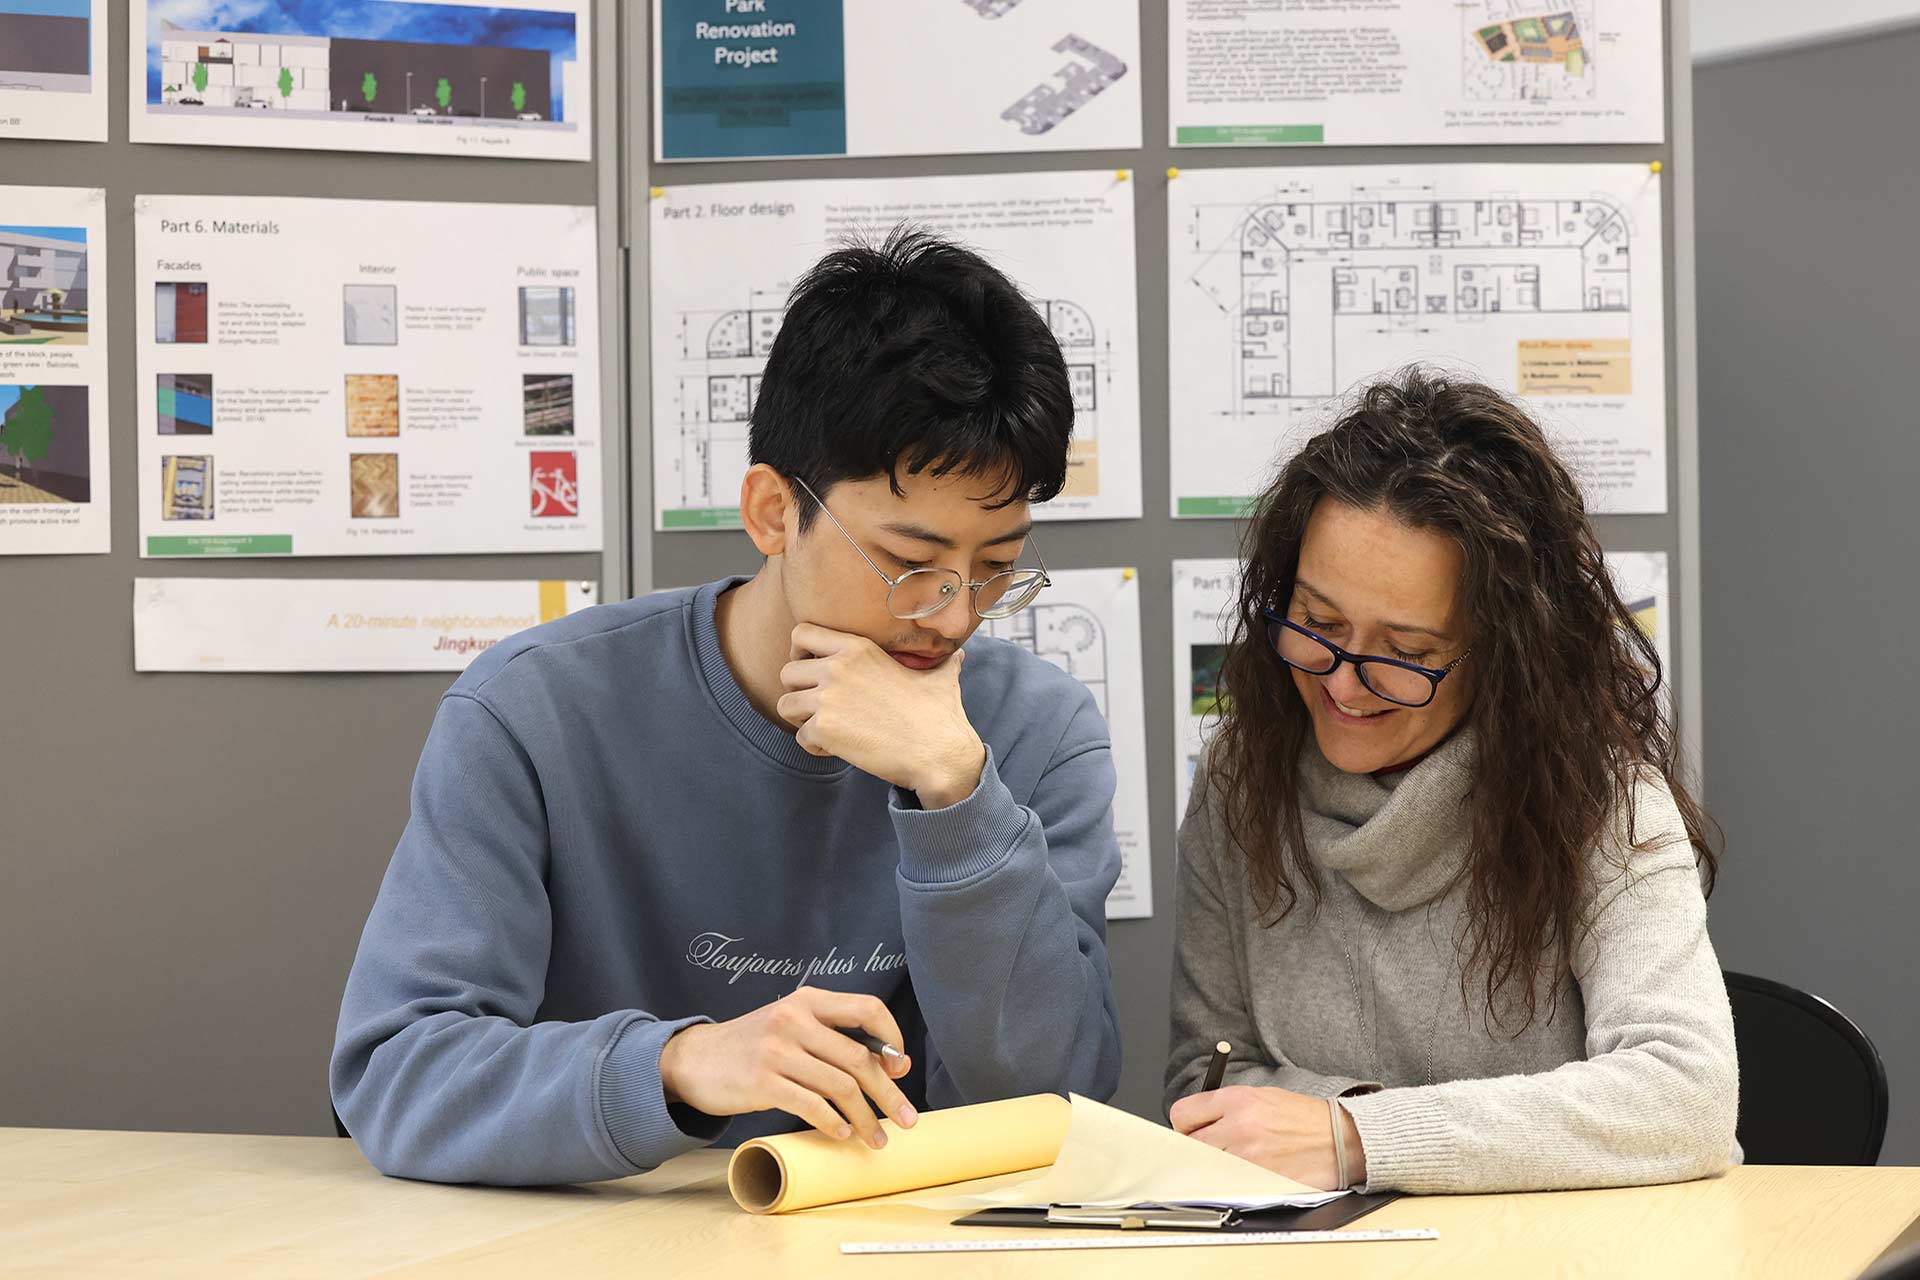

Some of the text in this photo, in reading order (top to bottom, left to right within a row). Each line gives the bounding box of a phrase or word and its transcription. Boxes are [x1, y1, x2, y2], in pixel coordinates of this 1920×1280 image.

[725, 0, 765, 13] Park
[696, 20, 795, 39] Renovation
[715, 47, 778, 68] Project
[663, 201, 795, 219] Part 2. Floor design
[160, 219, 280, 234] Part 6. Materials
[157, 259, 202, 271] Facades
[359, 263, 396, 274] Interior
[517, 266, 579, 278] Public space
[1193, 577, 1220, 590] Part
[327, 614, 535, 632] A 20-minute neighbourhood
[686, 932, 803, 985] Toujours
[796, 946, 858, 990] plus
